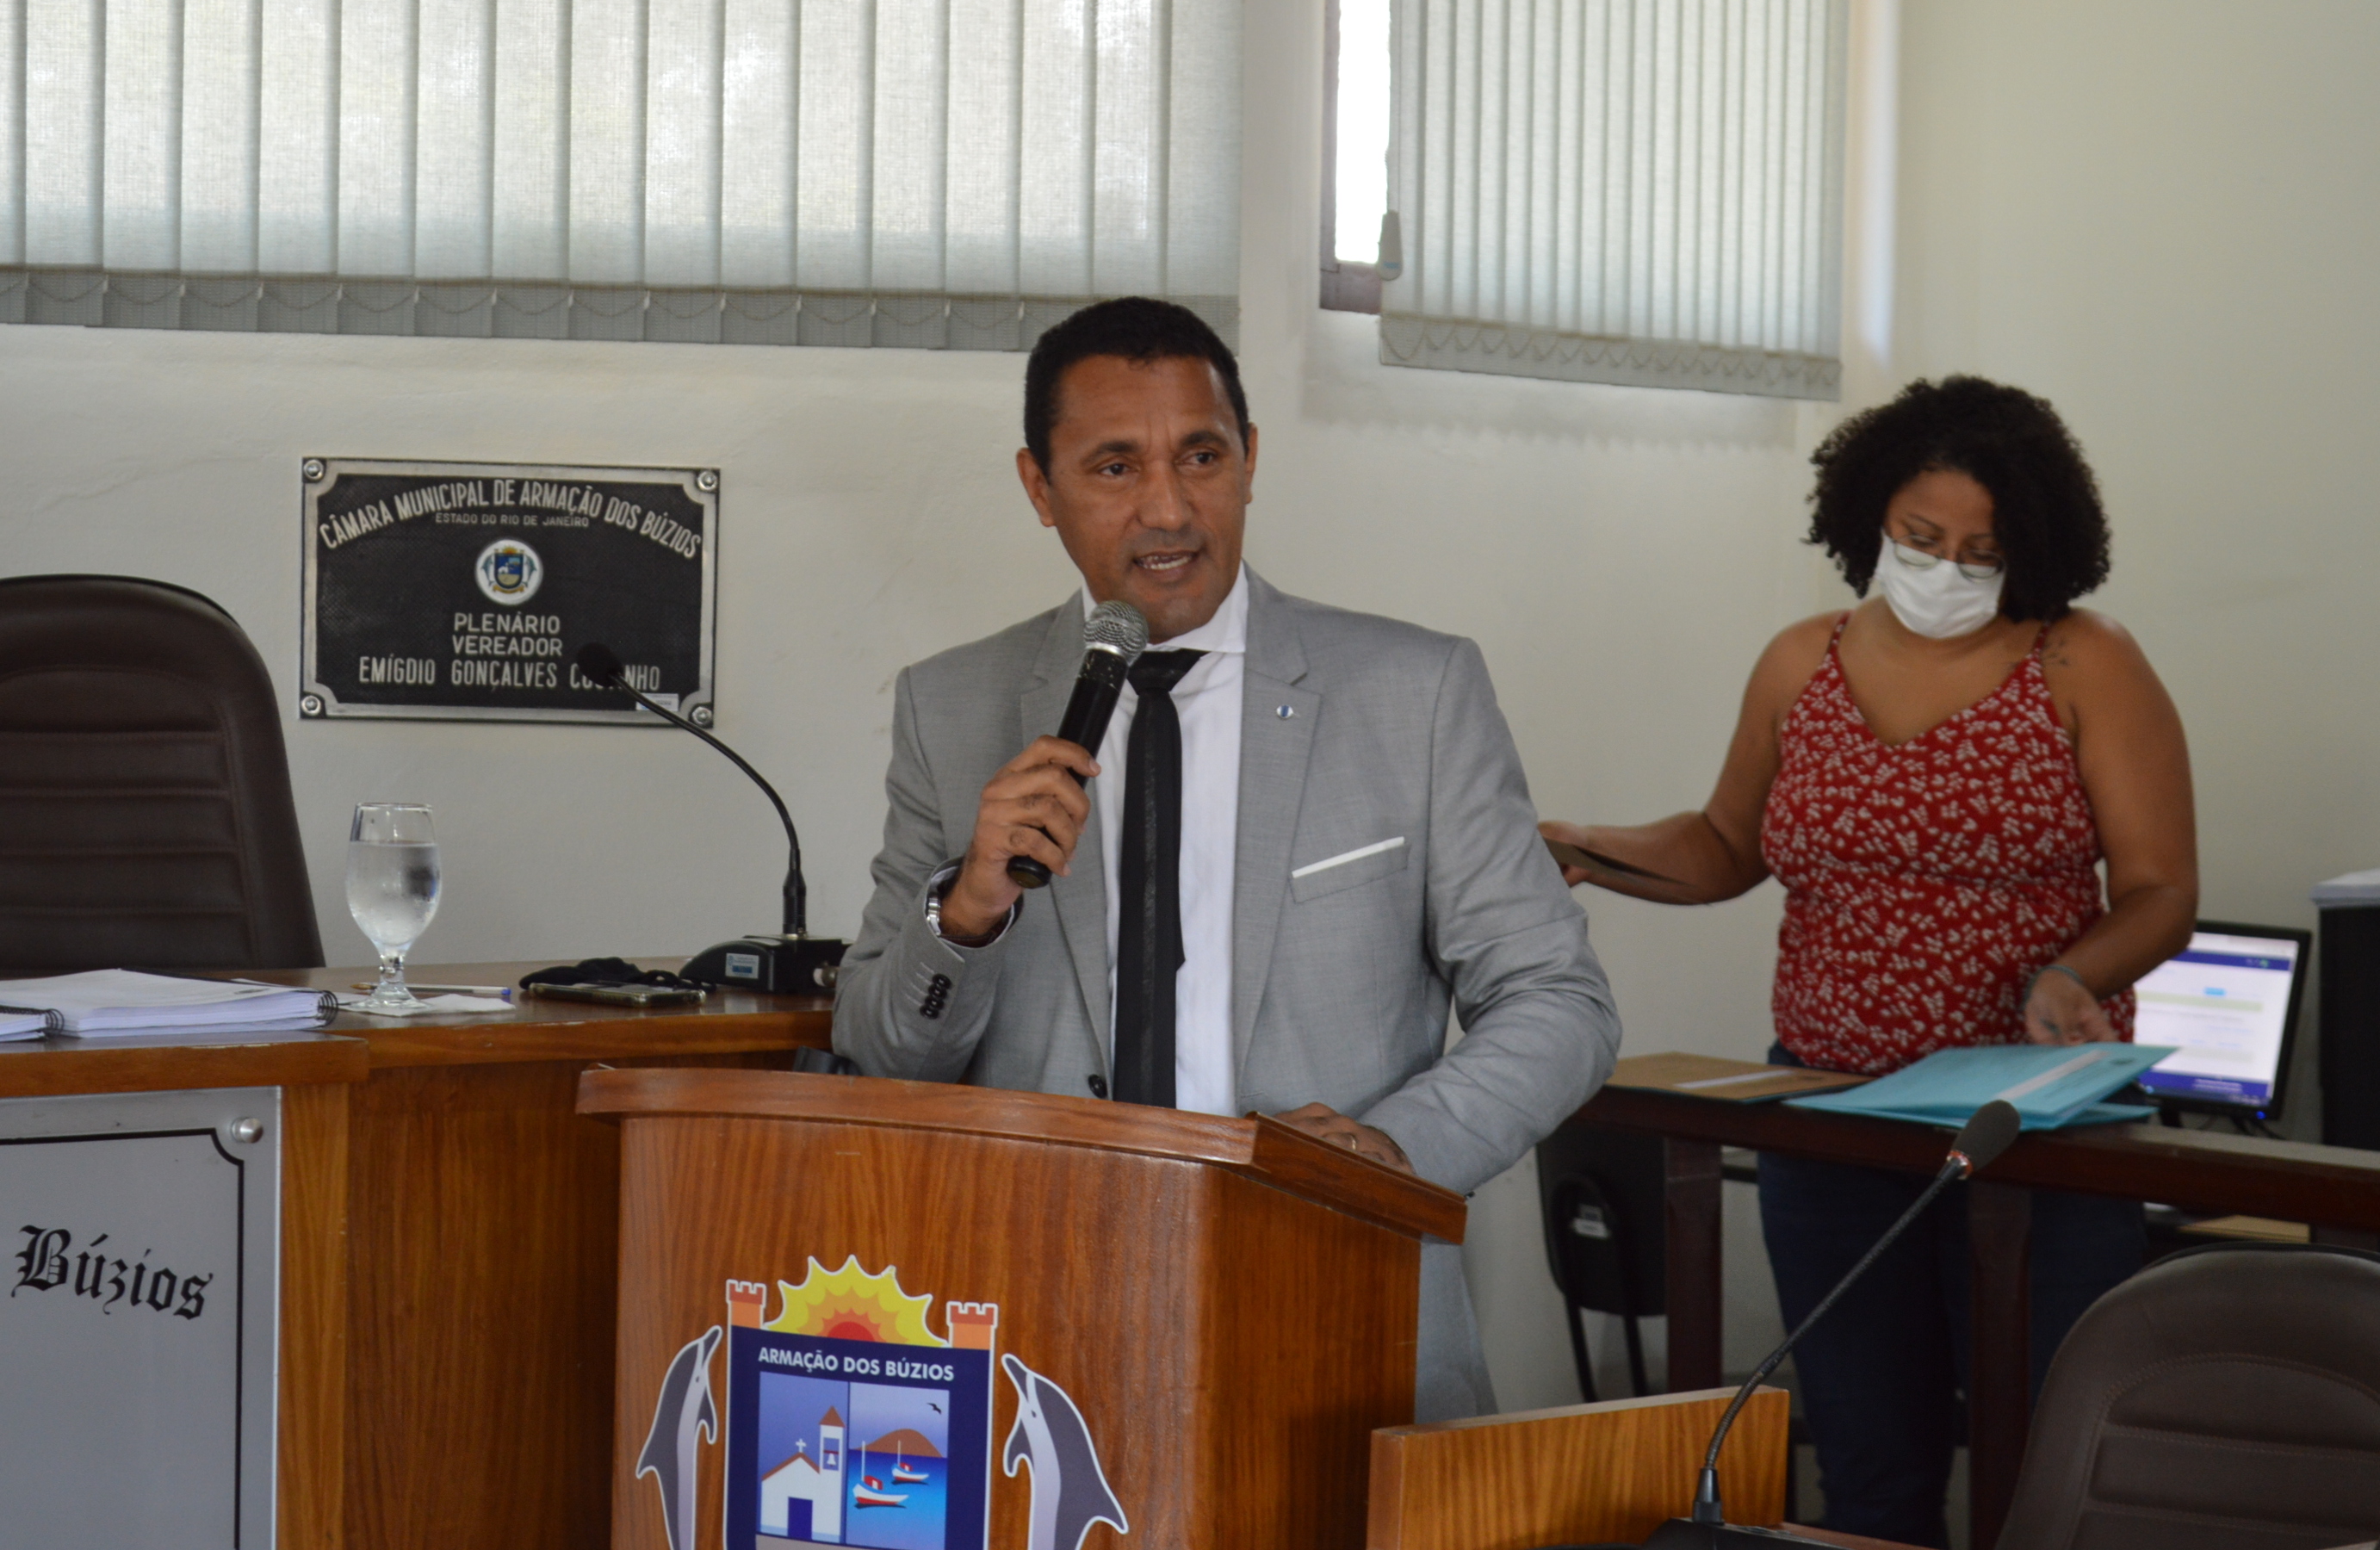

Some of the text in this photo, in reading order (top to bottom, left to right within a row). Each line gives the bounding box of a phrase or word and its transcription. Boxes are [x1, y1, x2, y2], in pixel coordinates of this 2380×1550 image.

[319, 479, 702, 559] CÂMARA MUNICIPAL DE ARMAÇÃO DOS BÚZIOS
[435, 512, 589, 528] ESTADO DO RIO DE JANEIRO
[454, 611, 561, 635] PLENÁRIO
[452, 635, 563, 657] VEREADOR
[359, 653, 436, 685] EMÍGDIO
[451, 659, 558, 692] GONÇALVES
[10, 1224, 214, 1320] Búzios
[758, 1346, 955, 1381] ARMAÇÃO DOS BÚZIOS
